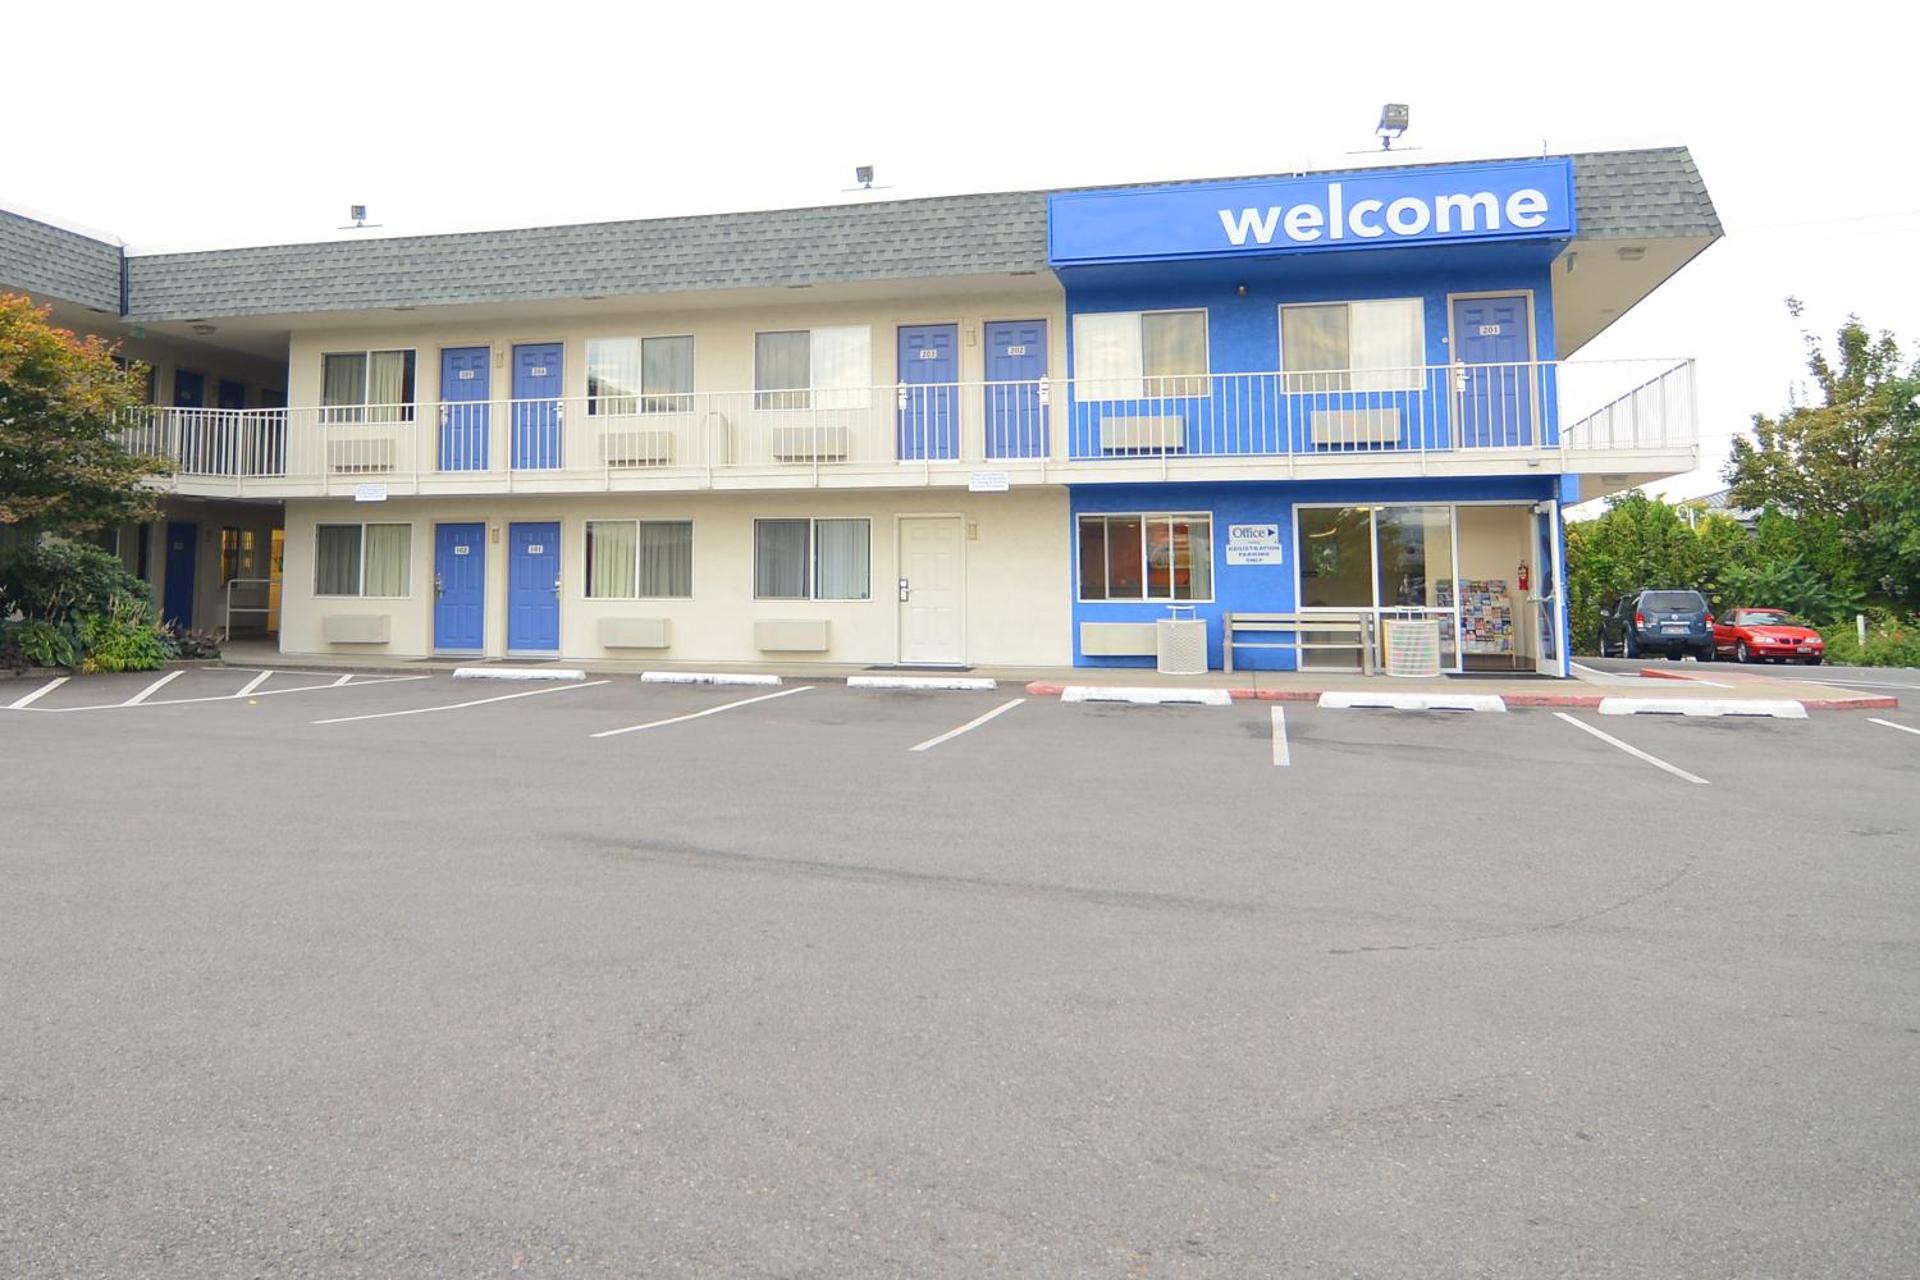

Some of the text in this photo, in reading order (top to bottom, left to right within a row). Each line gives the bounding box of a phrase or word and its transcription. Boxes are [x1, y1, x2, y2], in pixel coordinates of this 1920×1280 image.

[1218, 184, 1549, 245] welcome
[1483, 326, 1498, 334] 201
[1009, 346, 1024, 354] 202
[1232, 527, 1265, 538] Office
